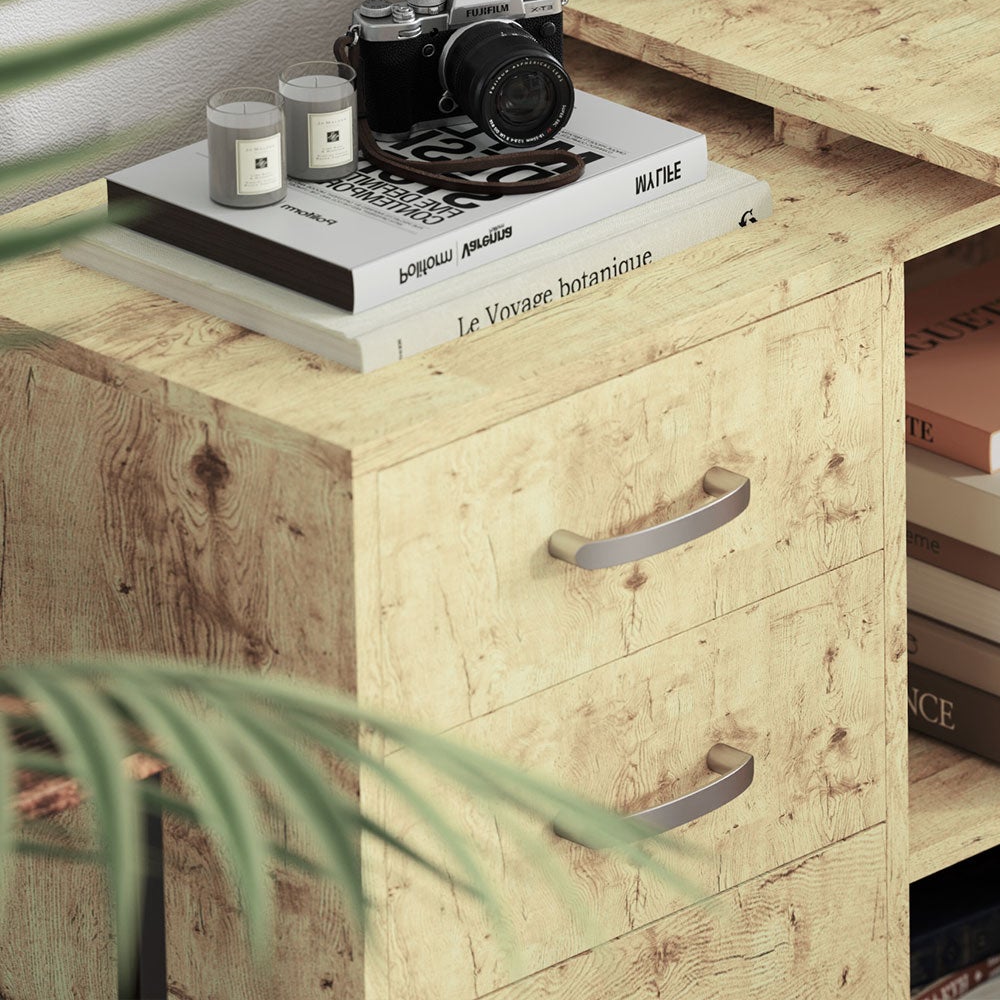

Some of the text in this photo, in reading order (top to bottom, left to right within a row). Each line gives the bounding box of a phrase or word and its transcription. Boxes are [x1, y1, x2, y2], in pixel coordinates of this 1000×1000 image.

[466, 3, 509, 18] FUJIFILM
[458, 250, 652, 337] Le Voyage botanique
